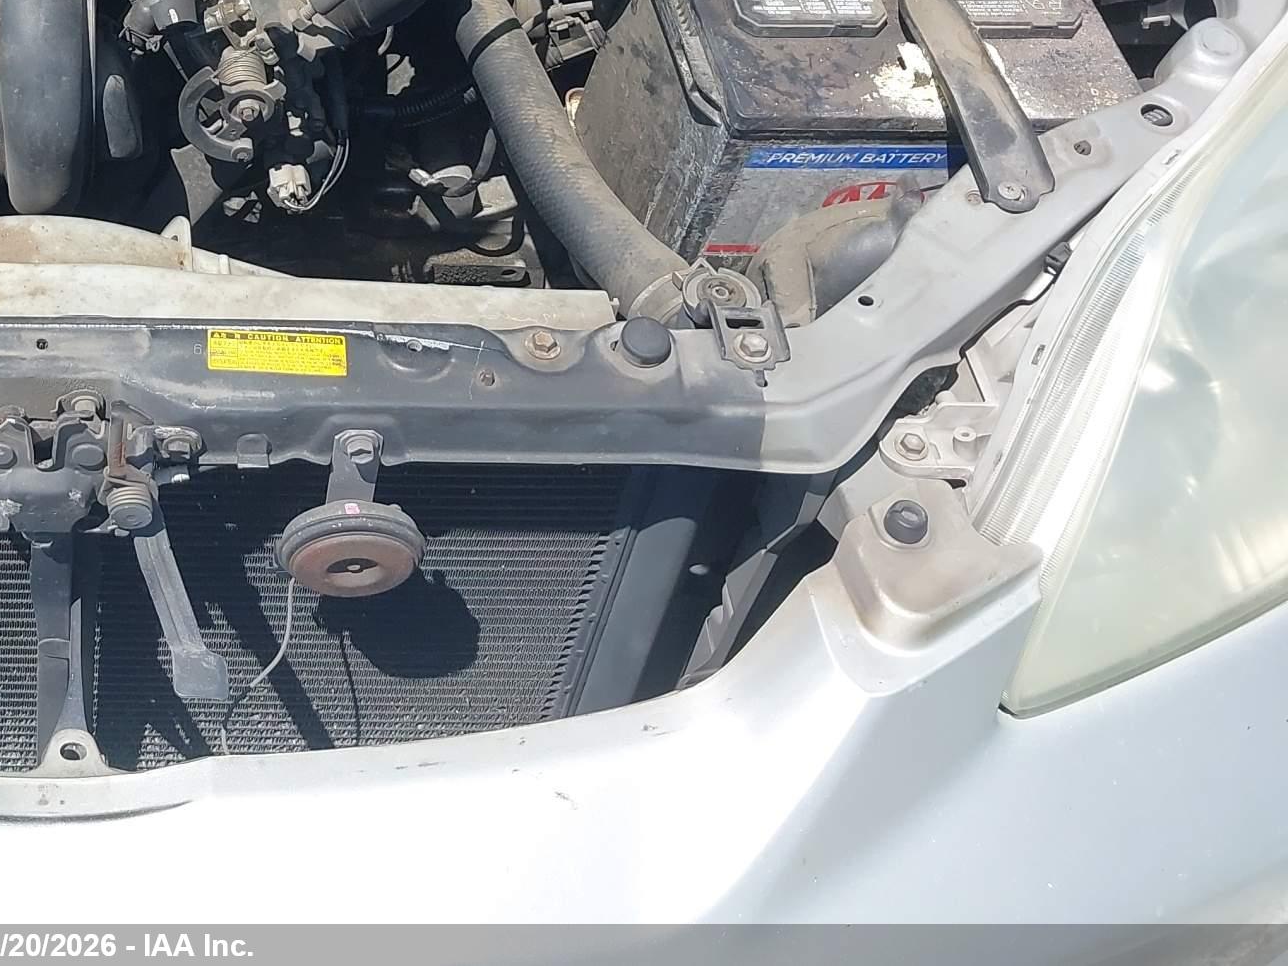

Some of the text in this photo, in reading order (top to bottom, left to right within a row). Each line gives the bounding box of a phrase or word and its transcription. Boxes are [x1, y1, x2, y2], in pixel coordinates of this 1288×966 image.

[767, 151, 949, 164] PREMIUM BATTERY
[247, 333, 289, 342] CAUTION
[295, 335, 342, 345] ATTENTION
